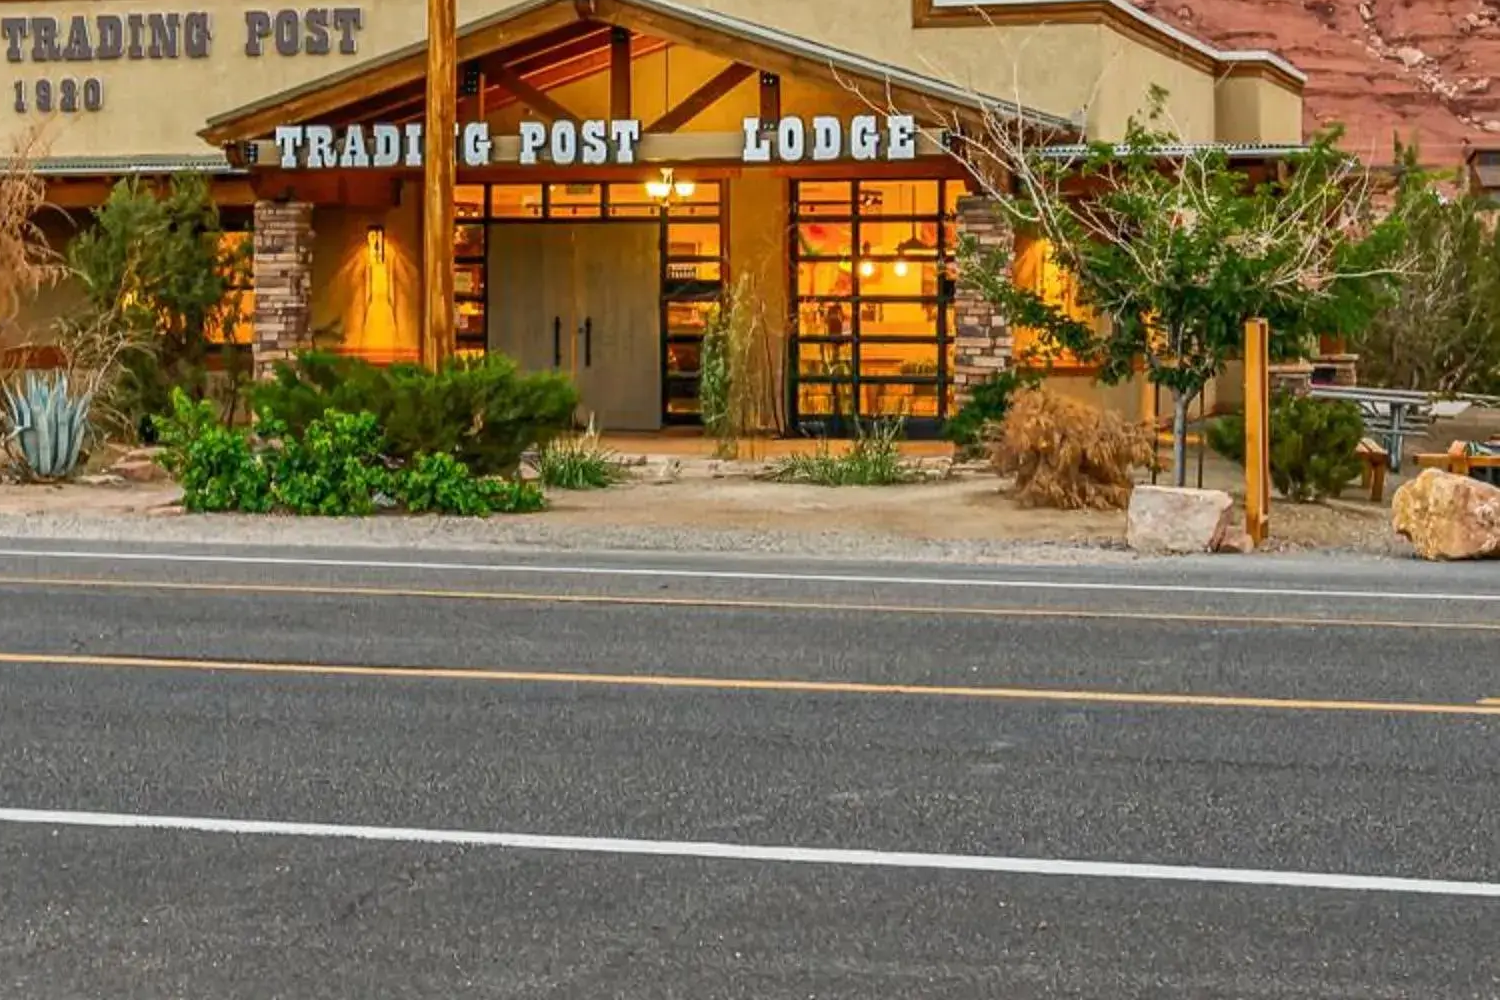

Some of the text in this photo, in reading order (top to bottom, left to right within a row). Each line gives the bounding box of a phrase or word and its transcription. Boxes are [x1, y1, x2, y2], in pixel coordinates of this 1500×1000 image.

[1, 11, 213, 62] TRADING
[244, 7, 364, 57] POST
[13, 77, 104, 113] 1920
[275, 119, 640, 169] TRADIG POST
[743, 115, 916, 162] LODGE
